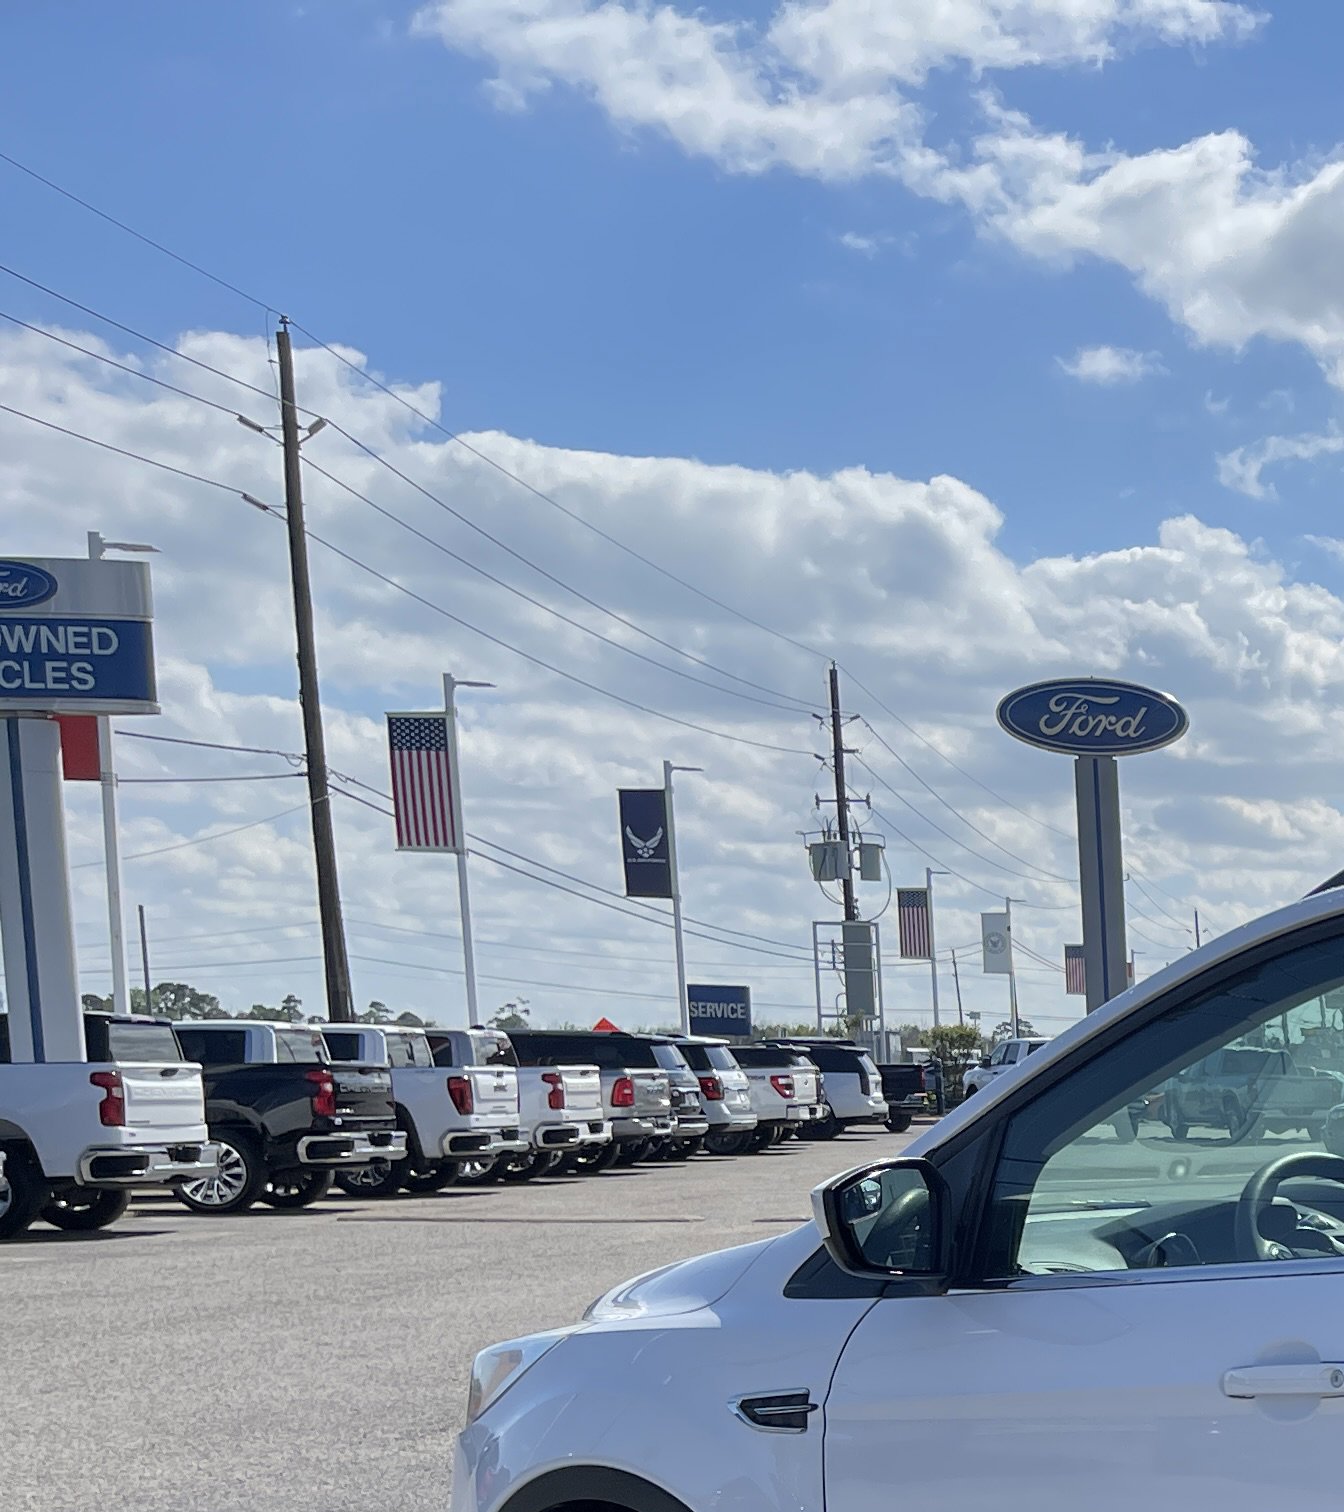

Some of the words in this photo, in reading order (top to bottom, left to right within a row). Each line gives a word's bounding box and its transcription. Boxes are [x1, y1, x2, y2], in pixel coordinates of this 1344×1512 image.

[0, 624, 119, 655] WNED
[1039, 693, 1148, 738] Ford
[689, 1001, 747, 1019] SERVICE
